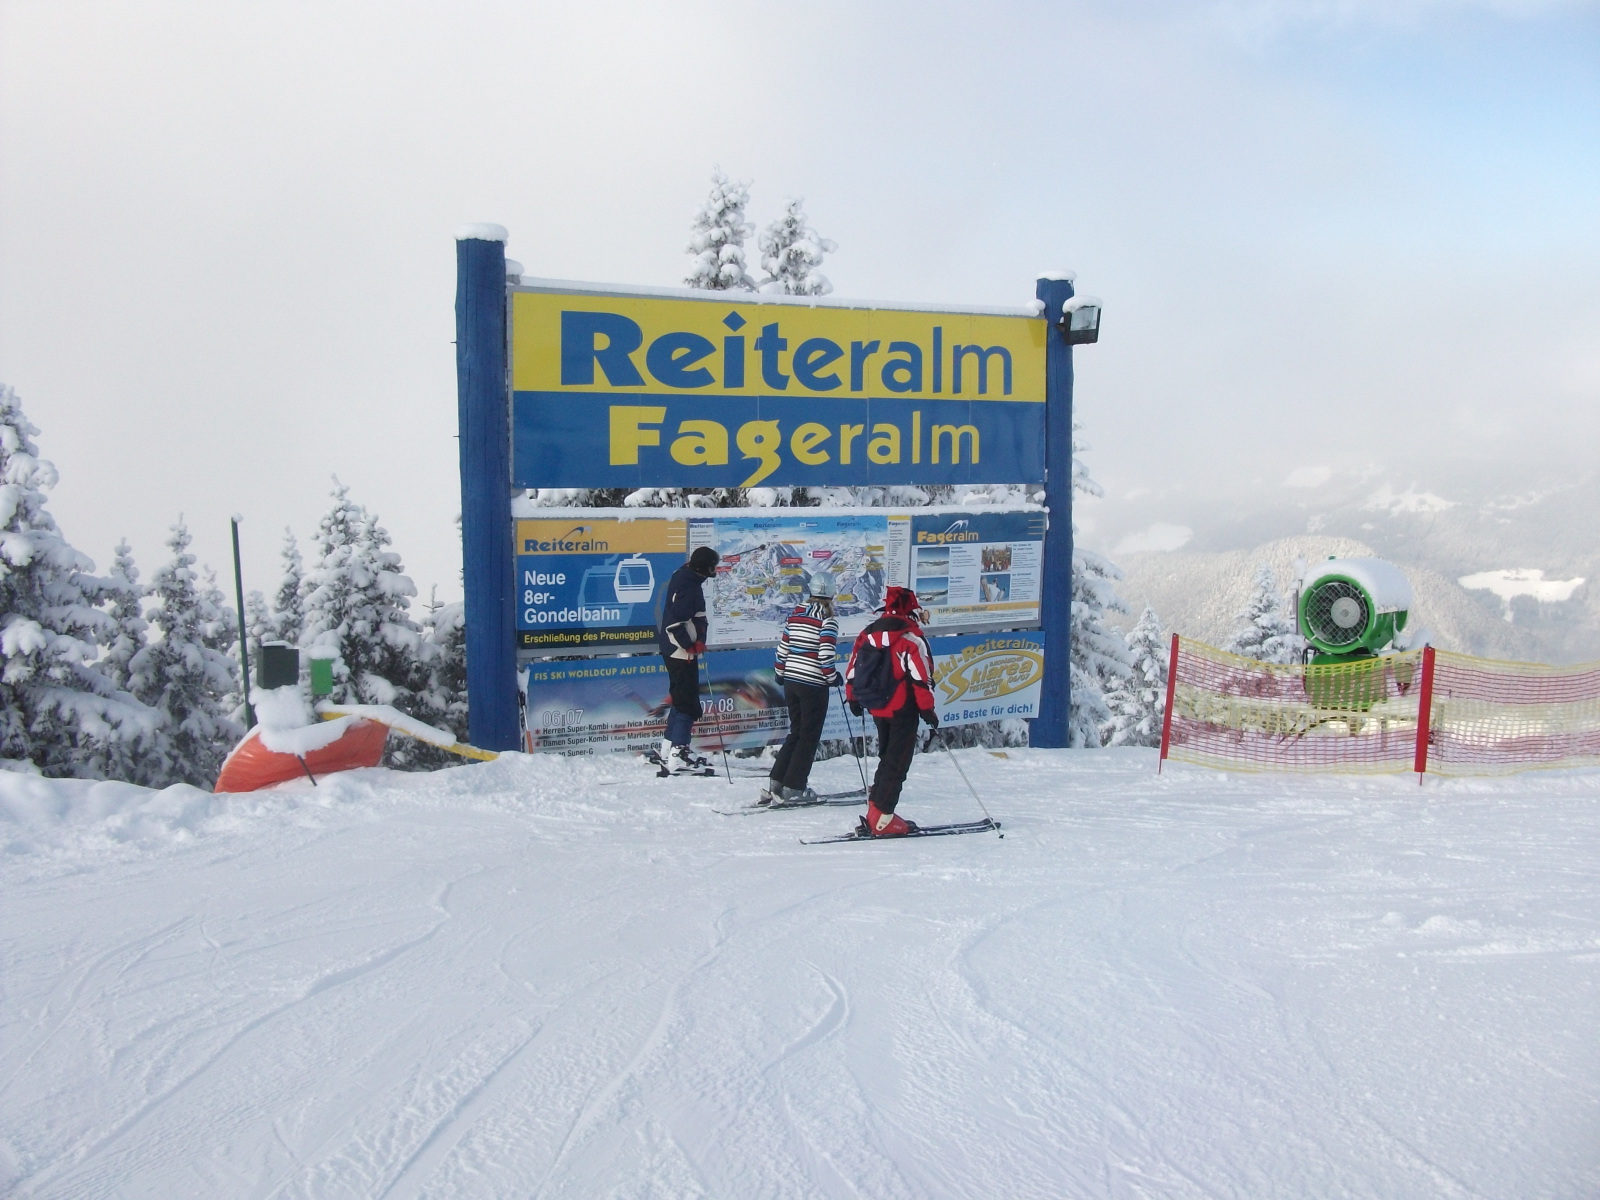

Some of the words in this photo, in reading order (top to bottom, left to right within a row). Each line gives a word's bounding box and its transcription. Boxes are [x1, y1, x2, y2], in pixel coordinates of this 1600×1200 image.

[561, 310, 1012, 396] Reiteralm
[609, 405, 980, 487] Fageralm
[524, 538, 608, 552] Reiteralm
[917, 529, 979, 546] Fageralm
[524, 571, 566, 586] Neue
[524, 590, 555, 605] 8er-
[524, 608, 621, 624] Gondelbahn
[524, 632, 581, 644] Erschließung
[583, 632, 598, 641] des
[600, 630, 655, 641] Preuneggtals
[534, 672, 548, 680] FIS
[551, 671, 566, 679] SKI
[568, 667, 618, 678] WORLDCUP
[620, 666, 637, 675] AUF
[640, 665, 656, 673] DER
[944, 712, 960, 722] das
[963, 708, 988, 719] Beste
[991, 705, 1005, 716] für
[1007, 703, 1033, 714] dich!
[543, 726, 565, 735] Herren
[567, 723, 609, 733] Super-Kombi
[698, 726, 718, 734] Herren
[543, 738, 565, 747] Damen
[567, 735, 609, 745] Super-Kombi
[628, 743, 649, 751] Renate
